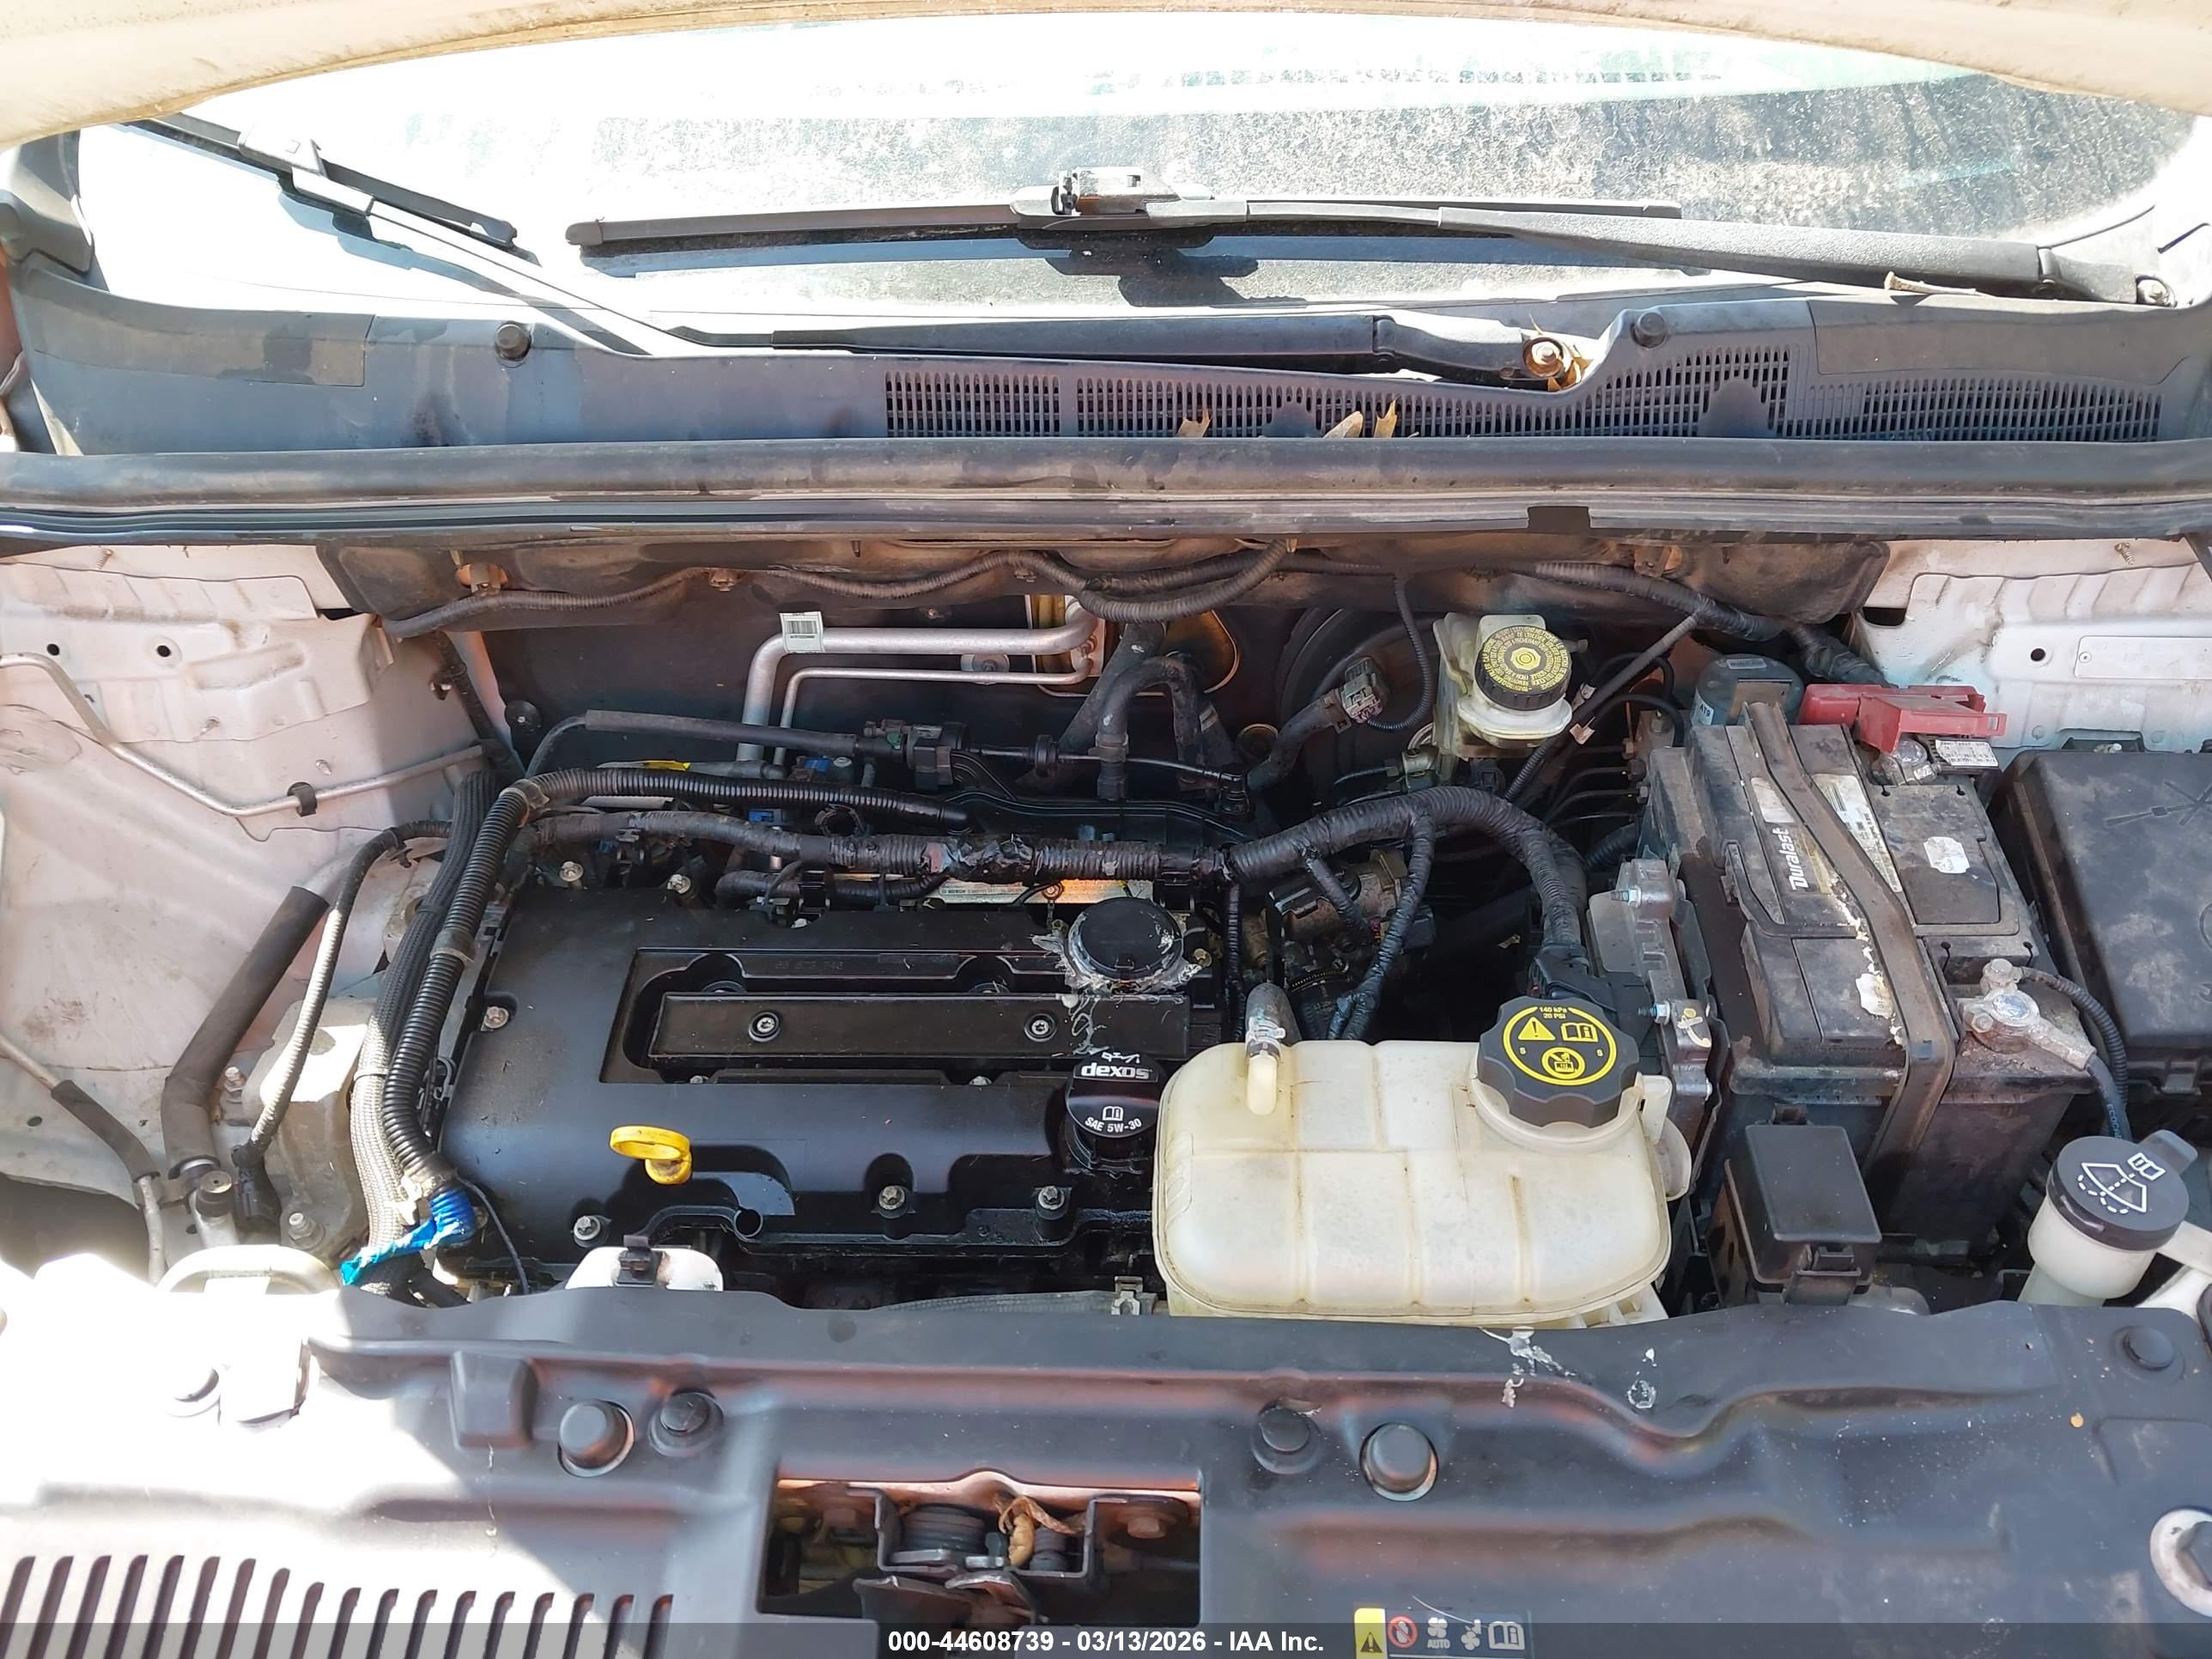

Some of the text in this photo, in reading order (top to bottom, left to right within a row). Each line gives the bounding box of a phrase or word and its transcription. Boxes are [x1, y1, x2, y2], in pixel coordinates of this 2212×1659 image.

[1771, 827, 1809, 890] Duralast
[1085, 1117, 1142, 1133] SAE 5W-30
[1427, 1638, 1450, 1649] AUTO
